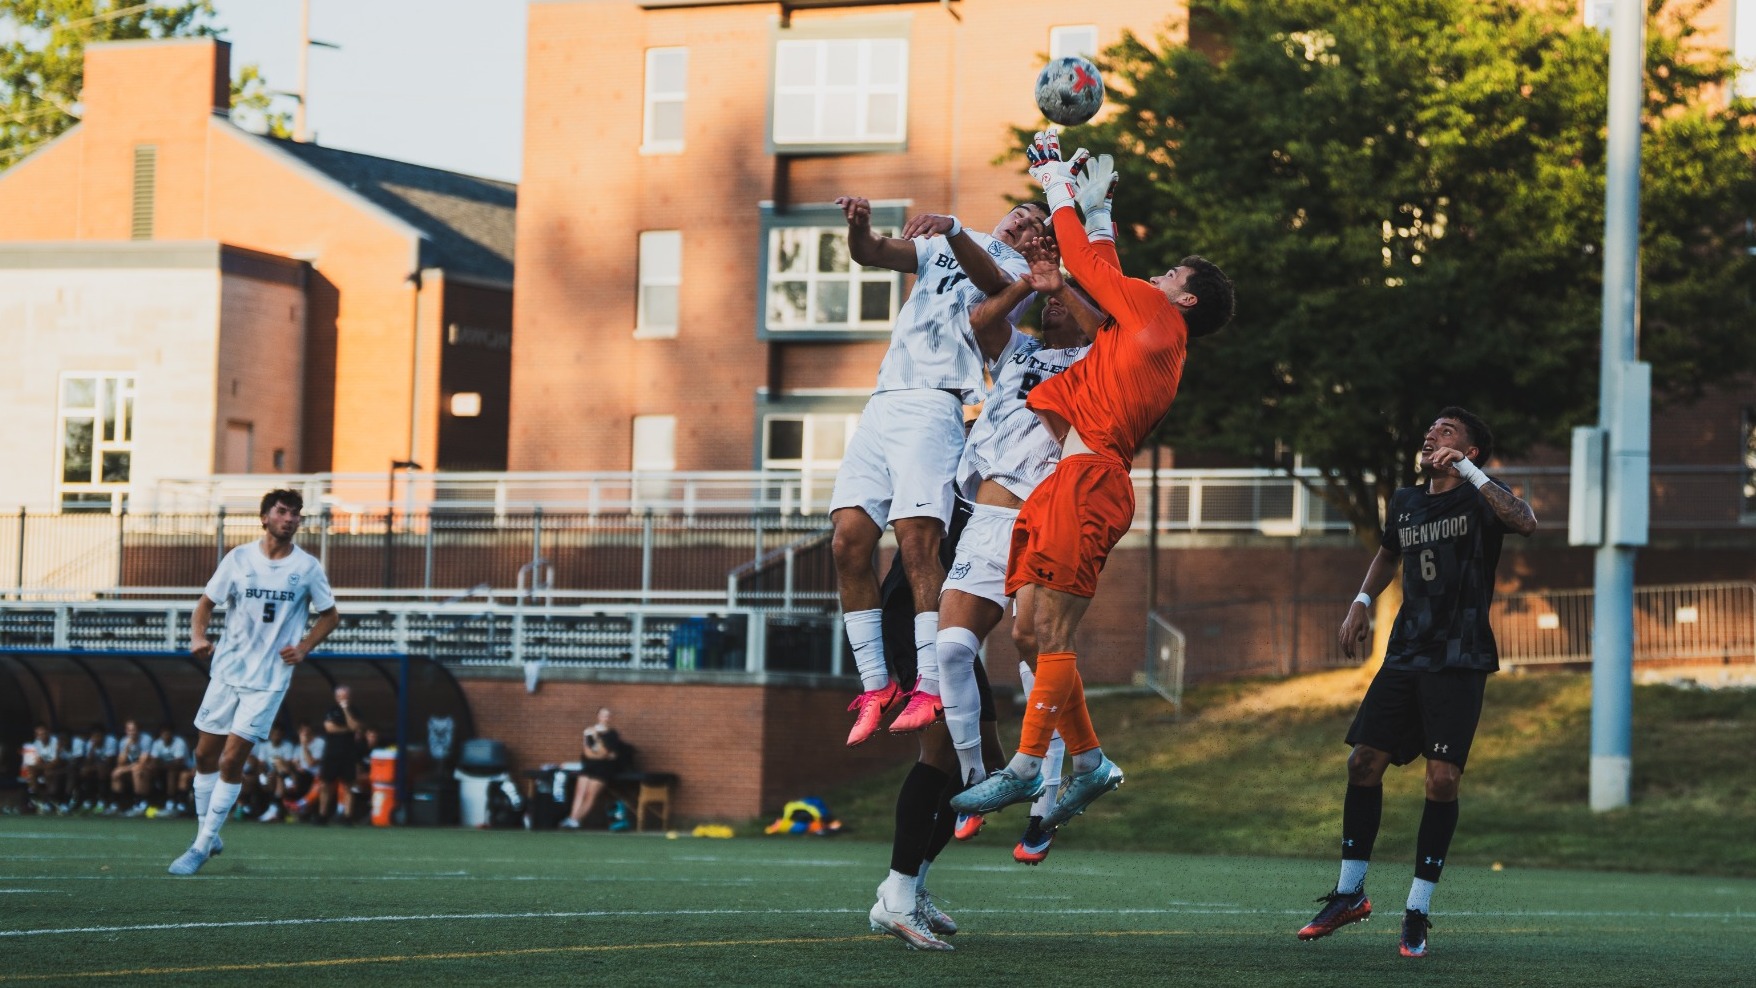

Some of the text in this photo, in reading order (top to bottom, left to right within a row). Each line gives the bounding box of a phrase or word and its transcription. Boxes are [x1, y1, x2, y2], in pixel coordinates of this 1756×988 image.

[1007, 353, 1070, 374] UTLE
[1420, 549, 1437, 581] 6
[245, 588, 296, 602] BUTLER
[262, 602, 276, 623] 5
